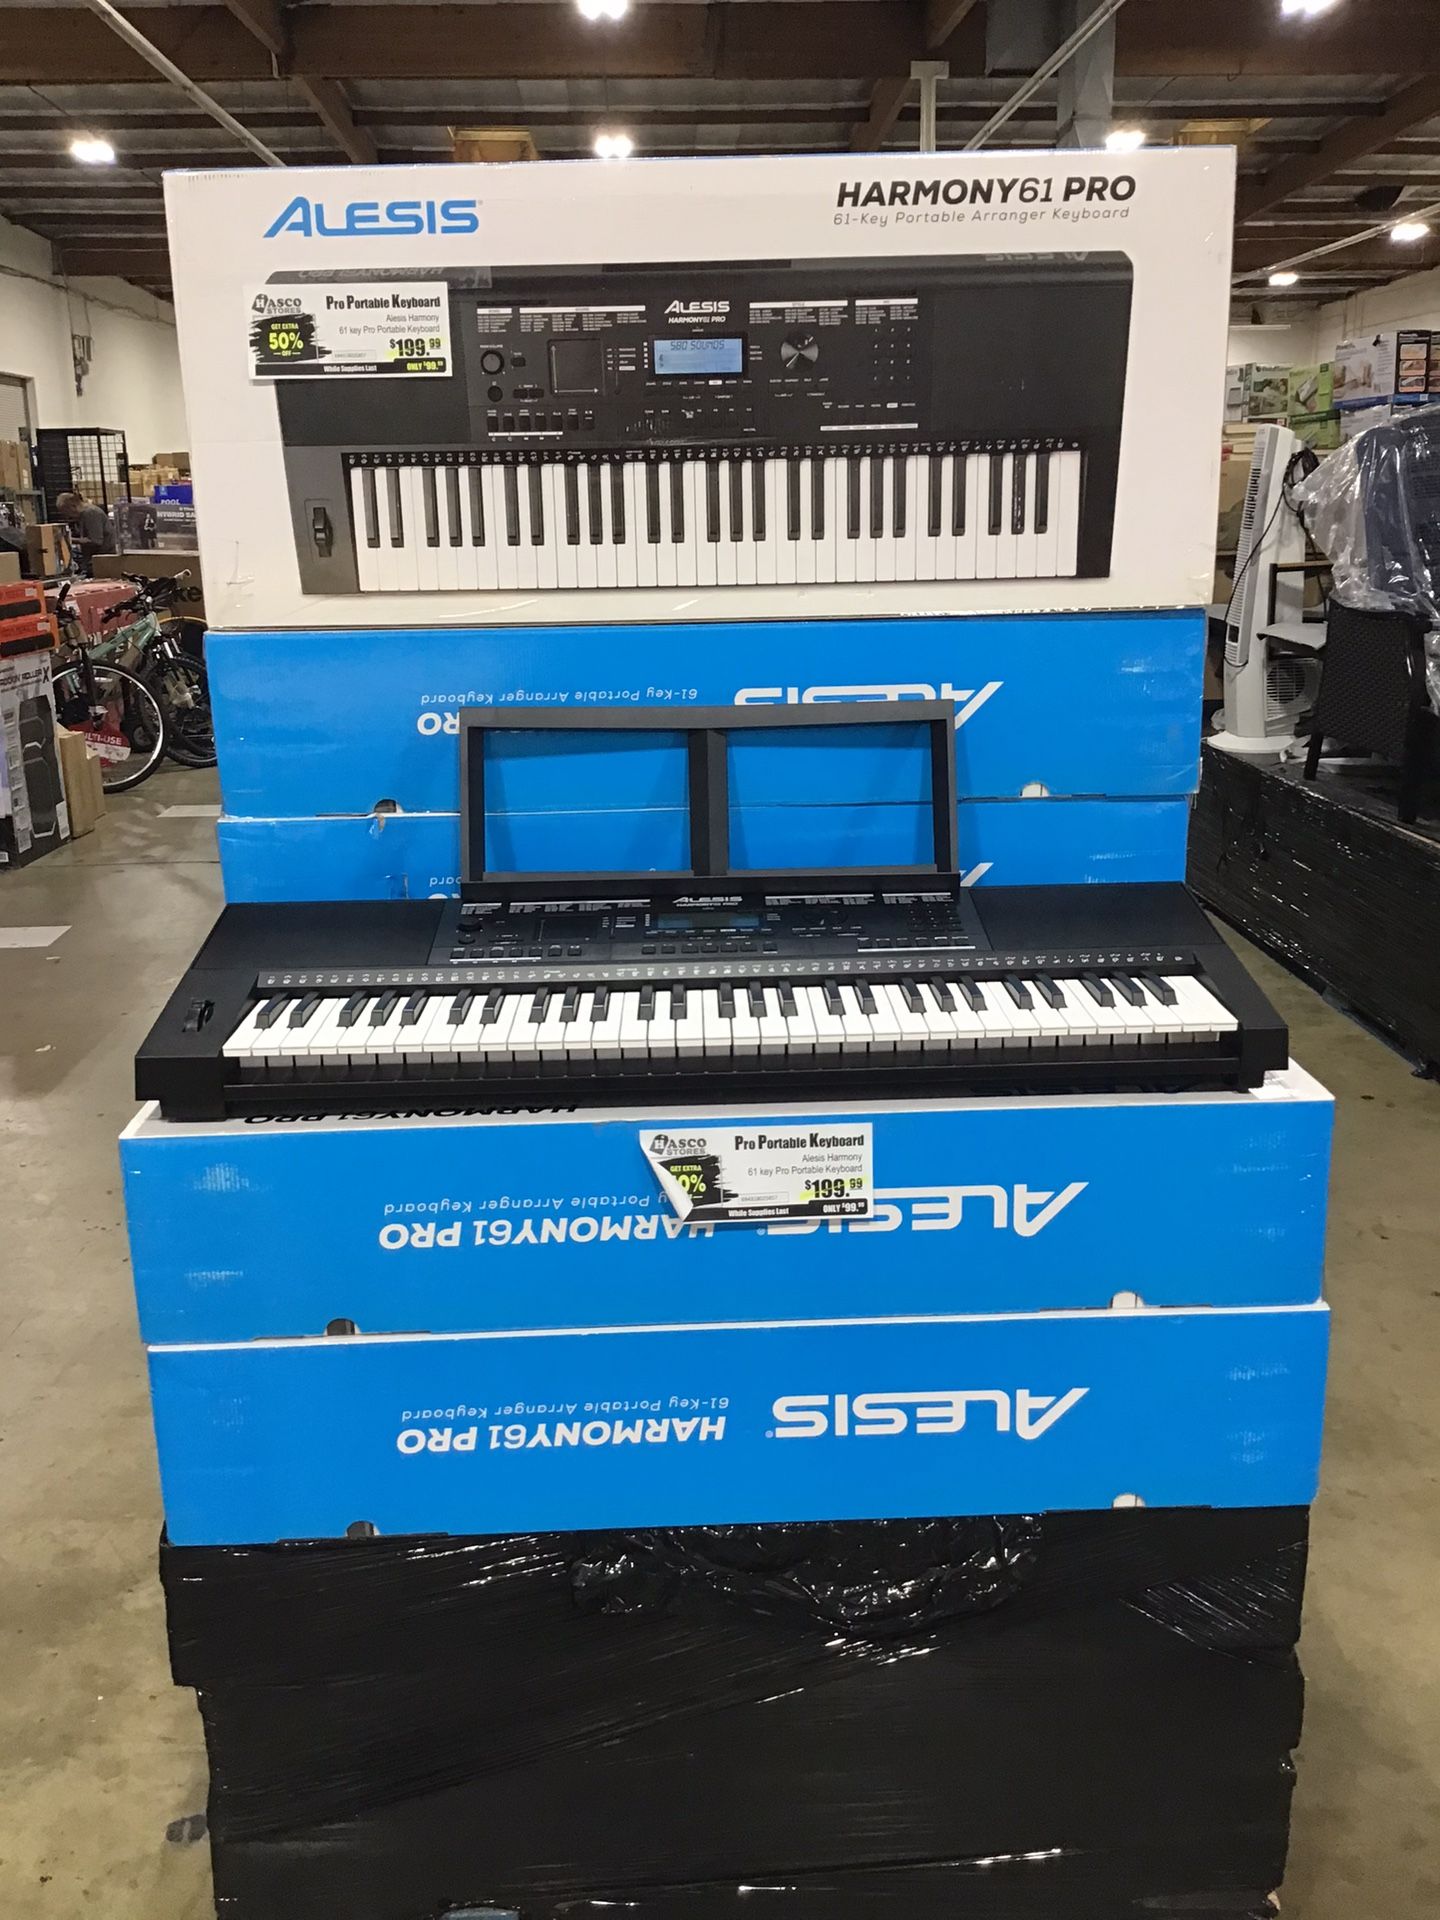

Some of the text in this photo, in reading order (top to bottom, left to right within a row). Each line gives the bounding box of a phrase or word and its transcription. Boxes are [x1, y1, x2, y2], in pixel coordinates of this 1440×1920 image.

[836, 175, 1136, 207] HARMONY61 PRO
[263, 196, 479, 238] ALESIS
[833, 206, 1130, 227] 61-Key Portable Arranger Keyboard
[253, 295, 302, 309] HASCO
[326, 294, 441, 310] Pro Portable Keyboard
[664, 300, 730, 314] ALESIS
[386, 313, 439, 324] Alesis Harmony
[339, 324, 440, 336] 61 key Pro Portable Keyboard
[269, 332, 304, 350] 50%
[390, 337, 441, 357] $199.99
[407, 362, 423, 371] ONLY
[421, 686, 698, 705] 61-Key Portable Arranger Keyboard
[417, 712, 461, 736] RO
[84, 732, 123, 745] ULTI-USE
[651, 1135, 707, 1151] HASCO
[735, 1133, 864, 1150] Pro Portable Keyboard
[667, 1148, 706, 1156] STORES
[802, 1153, 862, 1164] Alesis Harmony
[760, 1167, 774, 1178] key
[776, 1166, 790, 1175] Pro
[791, 1164, 824, 1175] Portable
[825, 1163, 863, 1175] Keyboard
[676, 1173, 707, 1193] 0%
[805, 1178, 863, 1198] $199.99
[384, 1199, 472, 1216] Keyboard
[479, 1196, 561, 1212] Arranger
[571, 1194, 650, 1210] Portable
[823, 1204, 840, 1213] ONLY
[775, 1207, 789, 1216] Last
[378, 1214, 717, 1250] HARMONY61 PRO
[402, 1394, 729, 1422] 61-Key Portable Arranger Keyboard
[772, 1387, 1091, 1440] ALESIS
[396, 1415, 727, 1454] HARMONY61 PRO
